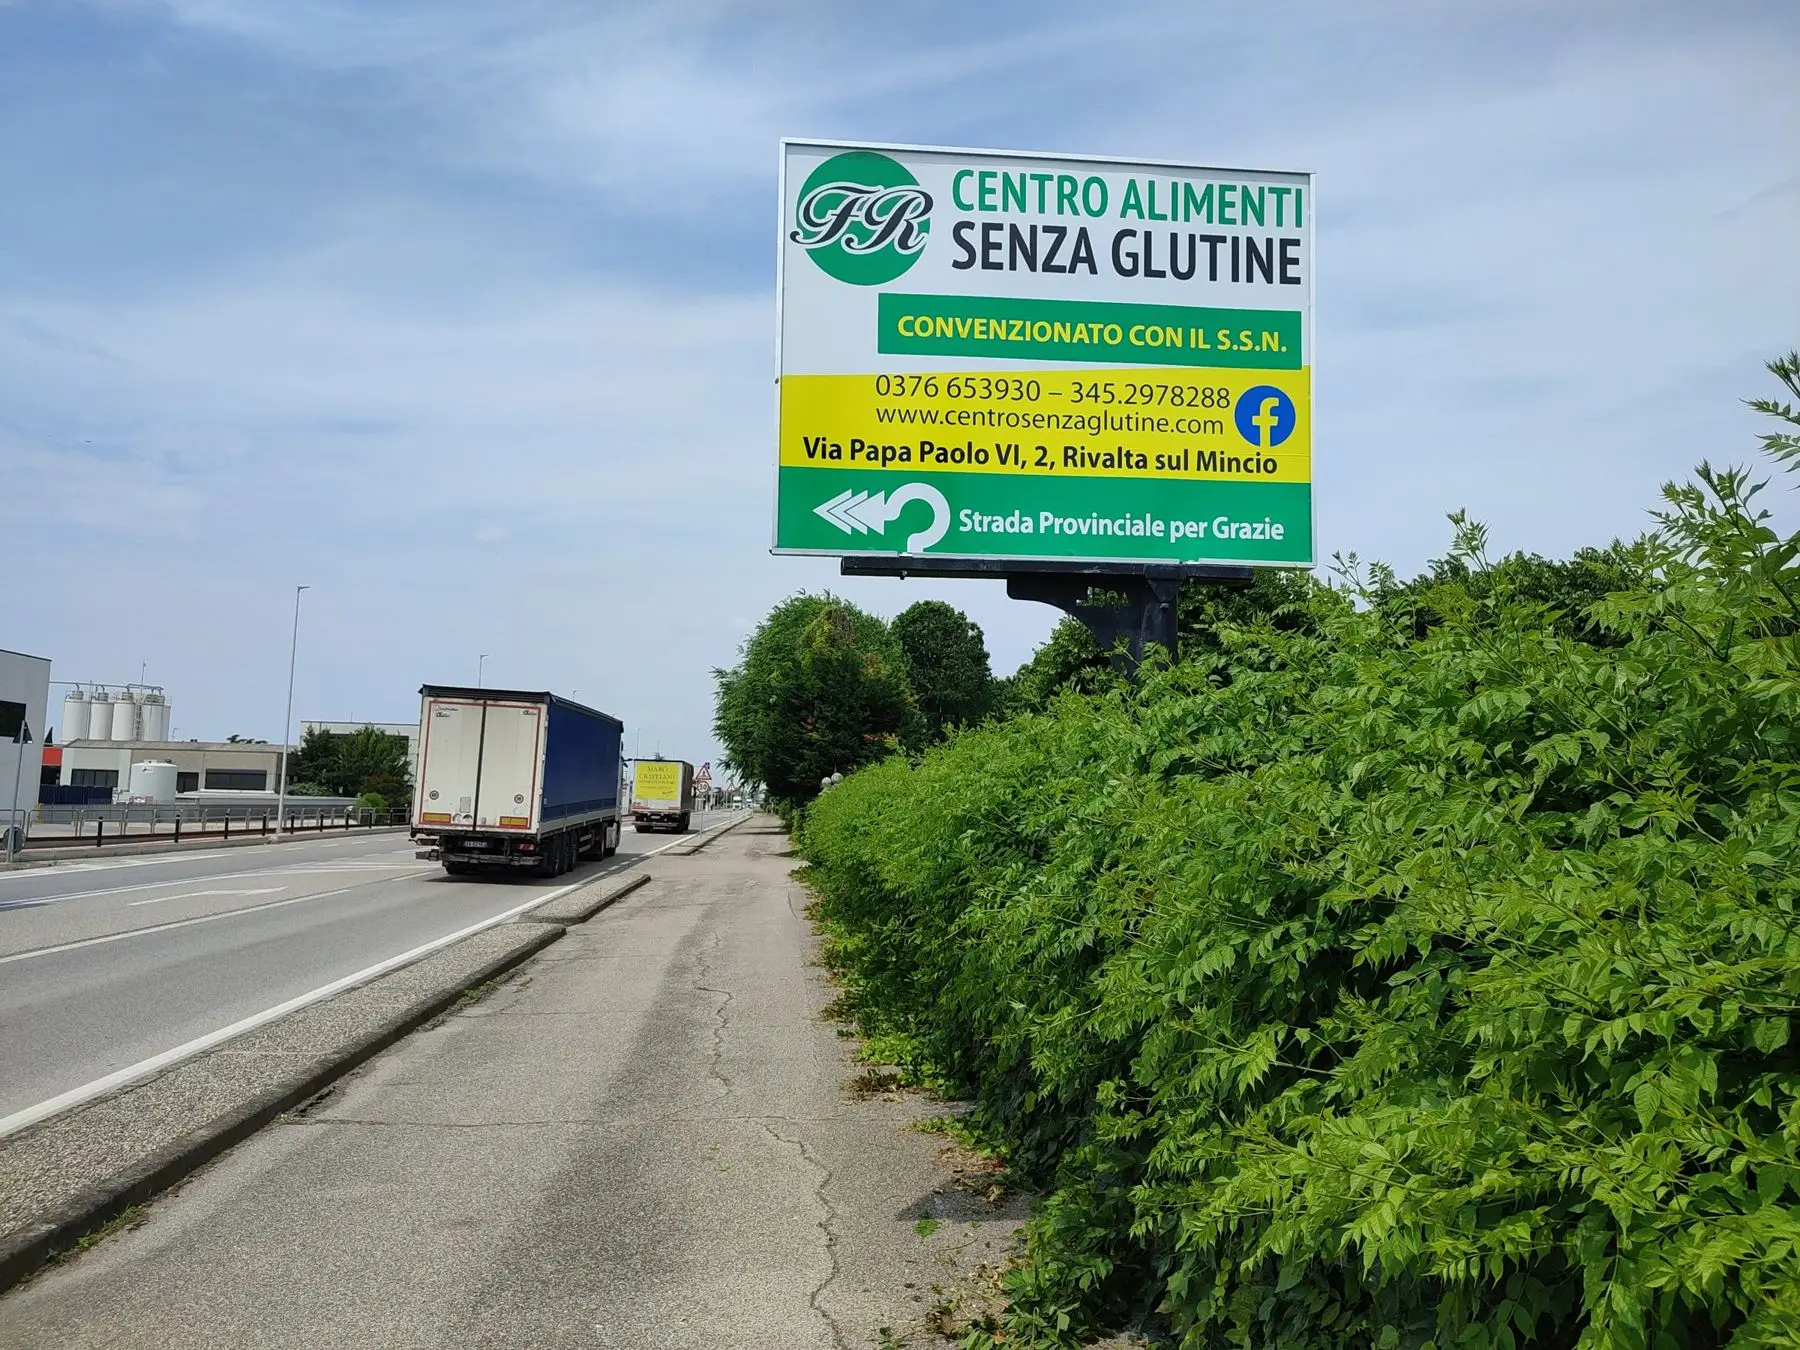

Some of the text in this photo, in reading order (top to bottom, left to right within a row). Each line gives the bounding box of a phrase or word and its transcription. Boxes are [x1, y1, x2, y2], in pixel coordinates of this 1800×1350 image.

[951, 169, 1304, 228] CENTRO ALIMENTI
[951, 220, 1301, 285] SENZA GLUTINE
[897, 315, 1288, 352] CONVENZIONATO CON IL S.S.N.
[875, 374, 939, 398] 0376
[946, 376, 1041, 402] 653930
[1070, 381, 1231, 409] 345.2978288
[876, 408, 1224, 436] www.centrosenzaglutine.com
[802, 436, 1278, 475] Via Papa Paolo VI, 2, Rivalta sul Mincio
[959, 509, 1285, 544] Strada Provinciale per Grazie
